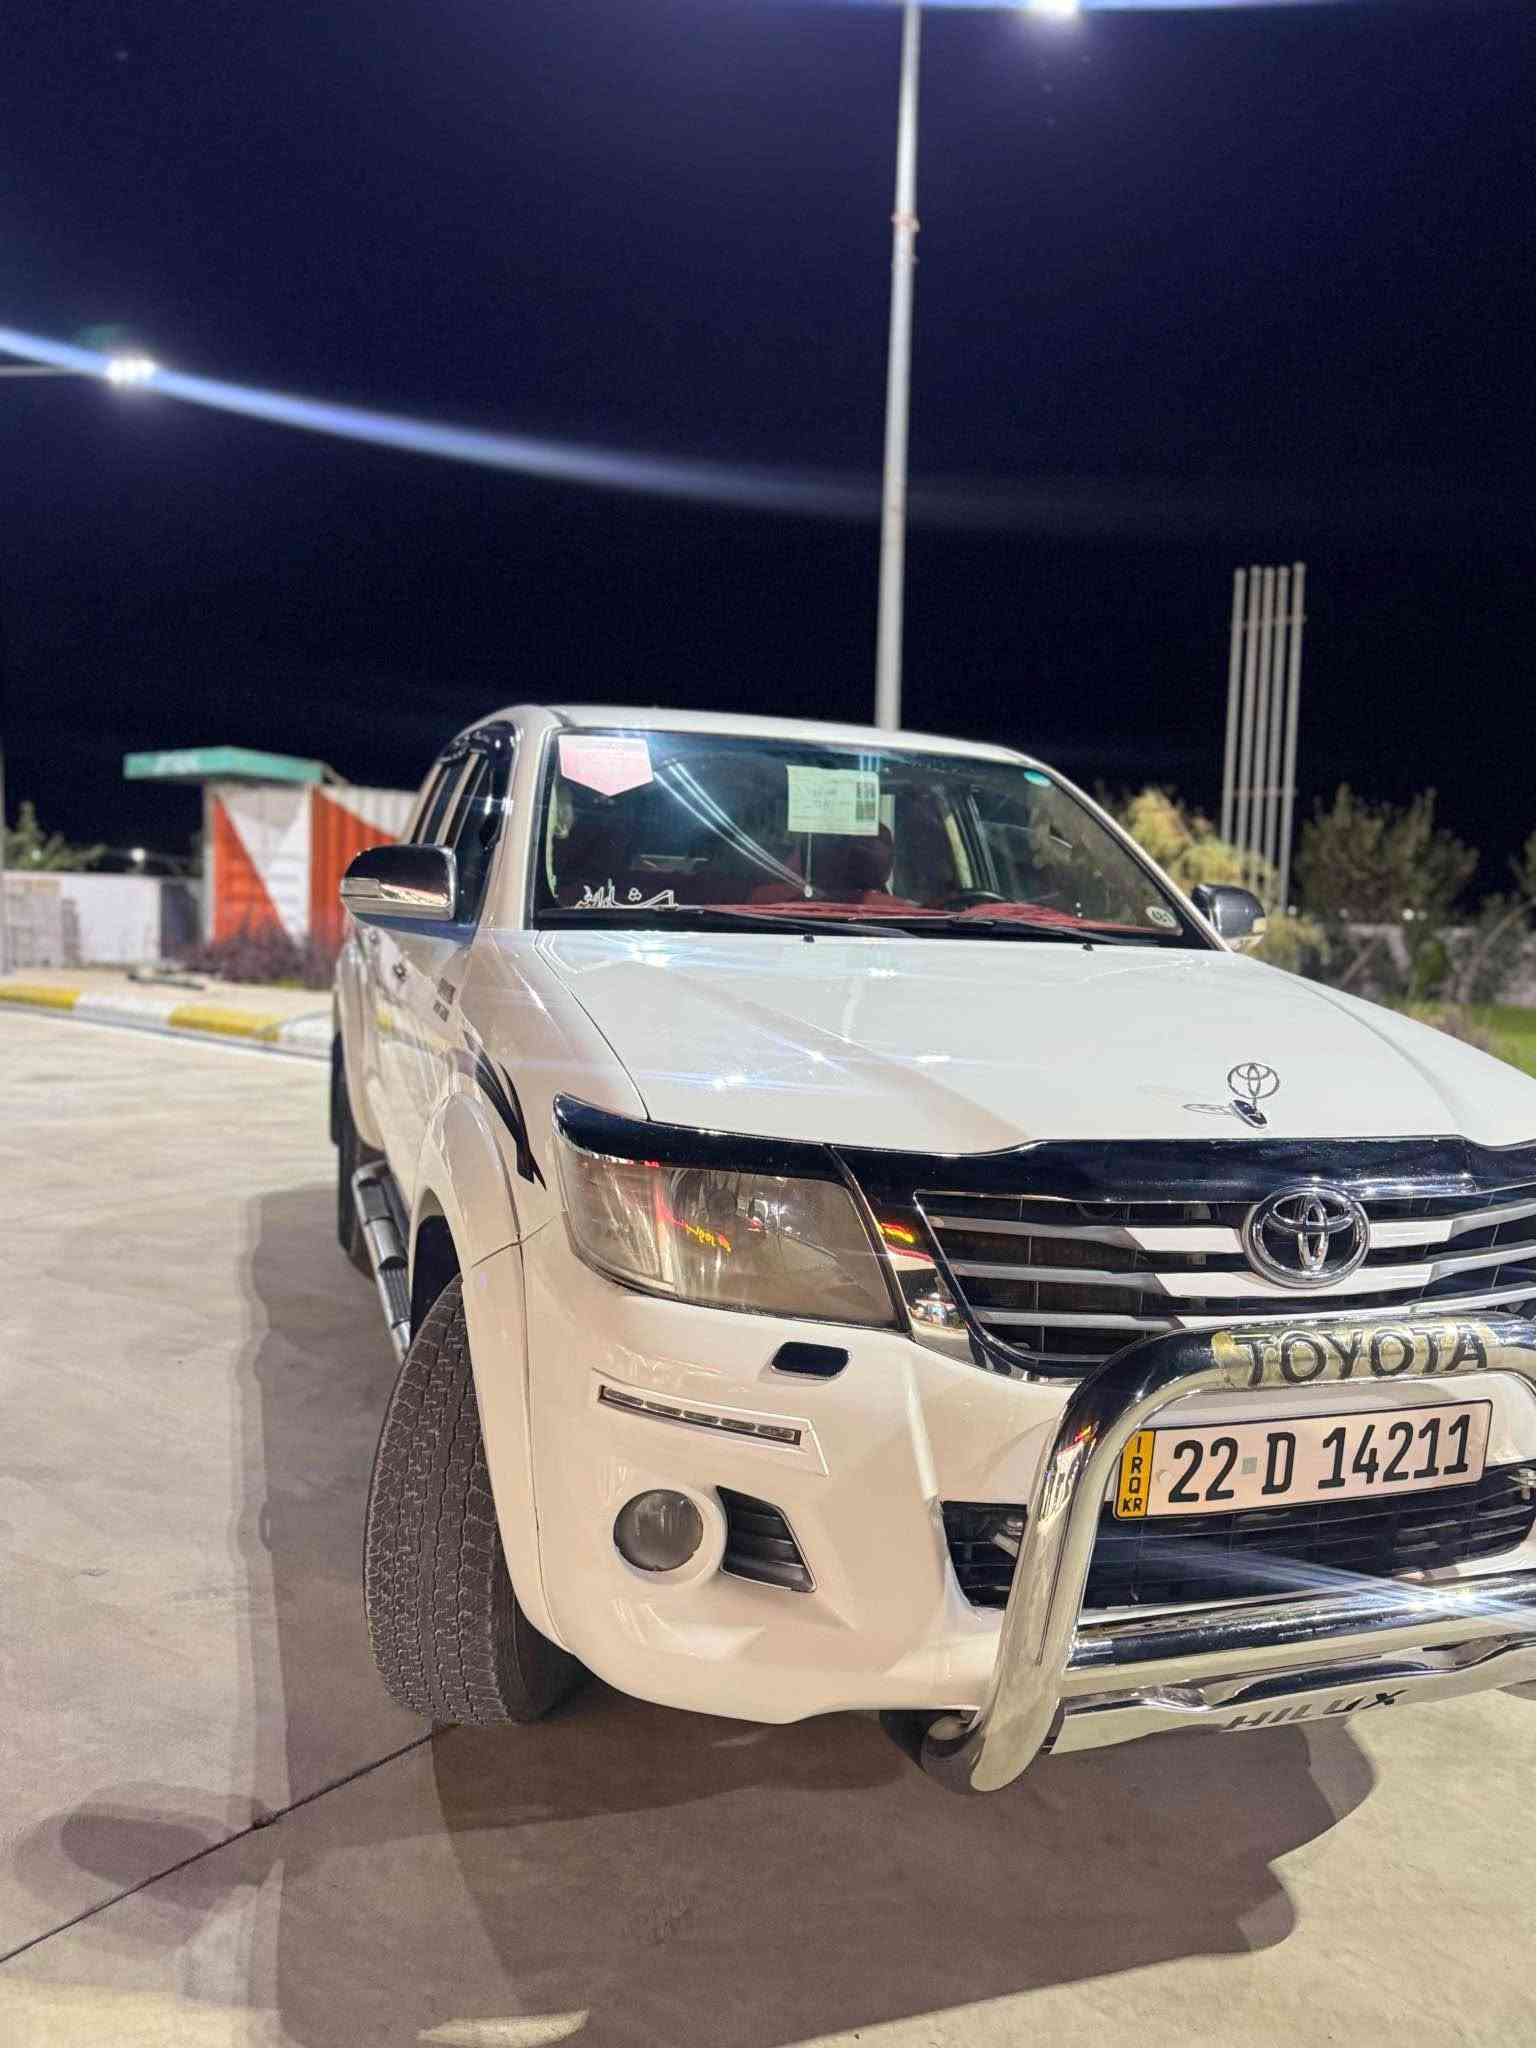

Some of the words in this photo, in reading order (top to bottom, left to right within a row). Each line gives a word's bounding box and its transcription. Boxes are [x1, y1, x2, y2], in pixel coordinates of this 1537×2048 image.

[1234, 1325, 1488, 1386] TOYOTA
[1168, 1437, 1239, 1503] 22
[1262, 1432, 1296, 1495] D
[1318, 1414, 1471, 1489] 14211
[1122, 1497, 1142, 1512] KR
[1224, 1689, 1408, 1730] HILUX
